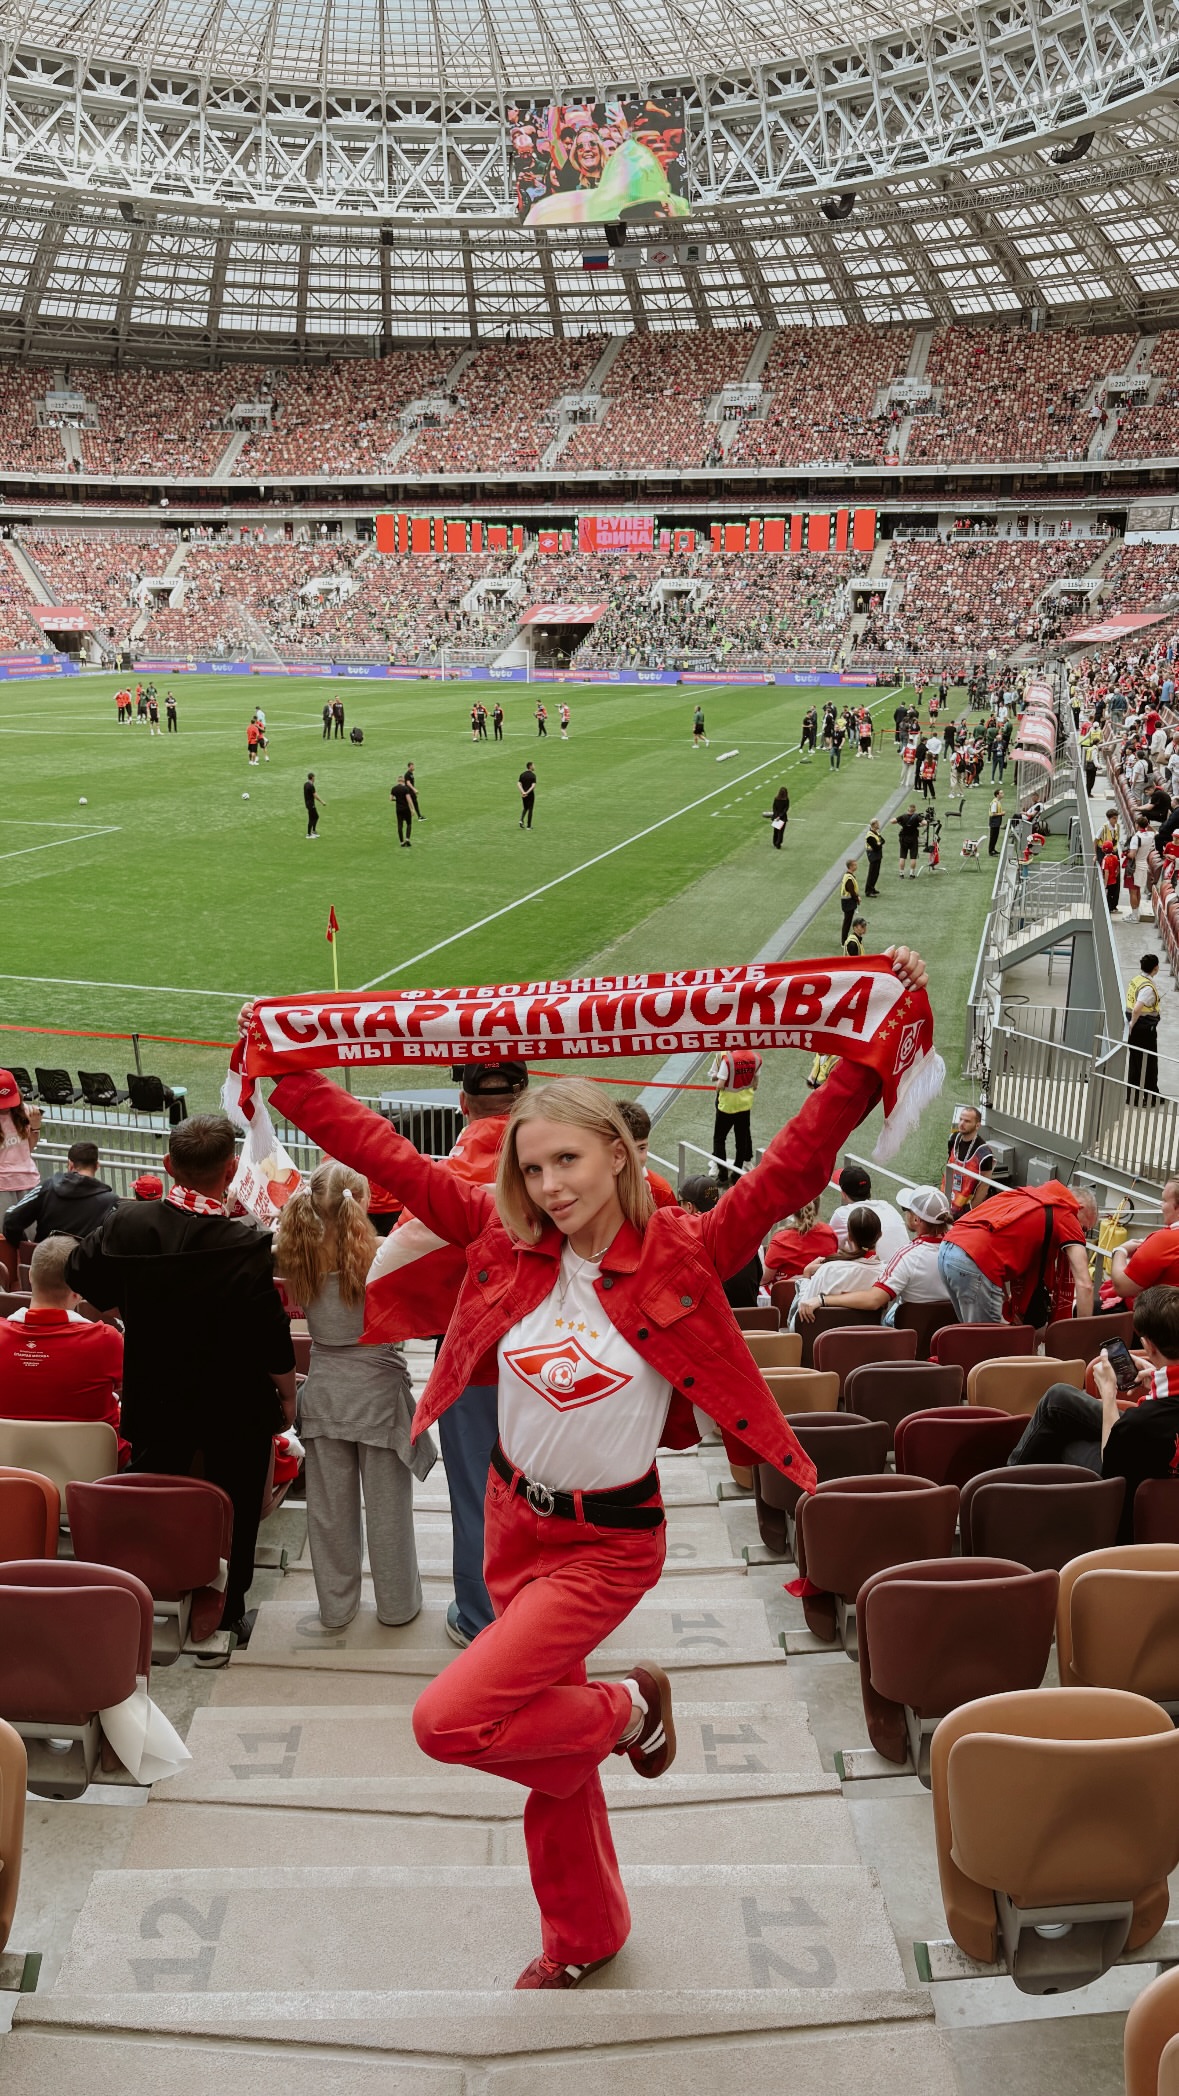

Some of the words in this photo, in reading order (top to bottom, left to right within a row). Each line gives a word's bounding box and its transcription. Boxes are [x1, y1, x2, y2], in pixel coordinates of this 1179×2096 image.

[596, 516, 654, 530] СУПЕР
[528, 613, 593, 623] BET
[537, 605, 600, 615] FON
[347, 666, 370, 674] tutu
[489, 669, 512, 678] tutu
[638, 672, 662, 680] tutu
[400, 975, 649, 1000] ФУТБОЛЬНЫЙ
[664, 965, 766, 987] КЛУБ
[274, 996, 571, 1043] СПАРТАК
[578, 975, 875, 1034] МОСКВА
[337, 1043, 392, 1060] МЫ
[402, 1040, 548, 1058] ВМЕСТЕ!
[562, 1036, 622, 1055] МЫ
[631, 1031, 813, 1051] ПОБЕДИМ!
[229, 1725, 303, 1780] 11
[701, 1723, 769, 1774] 11
[129, 1895, 230, 1993] 12
[741, 1896, 838, 1990] 12
